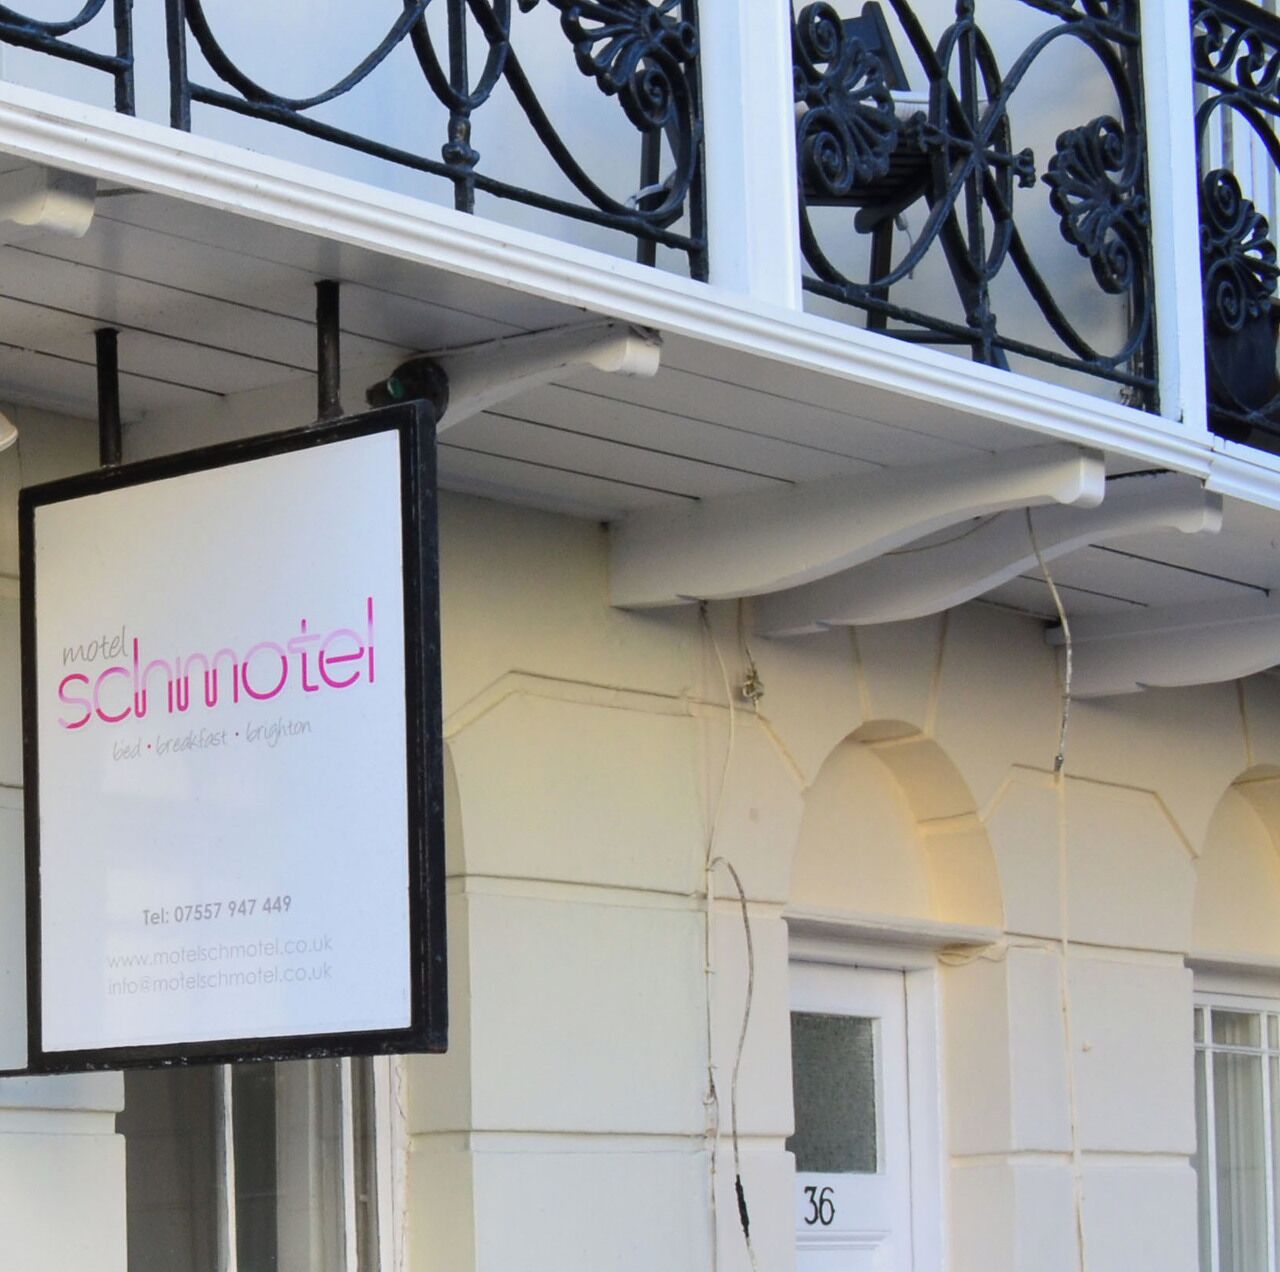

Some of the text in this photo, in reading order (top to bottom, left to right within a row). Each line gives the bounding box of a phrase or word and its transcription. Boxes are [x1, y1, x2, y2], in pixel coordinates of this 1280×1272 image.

[58, 597, 375, 729] schmotel
[62, 624, 129, 666] motel
[112, 720, 312, 762] bed breakfast brighton
[142, 895, 292, 926] Tel: 07557 947 449
[106, 933, 334, 969] www.motelschmotel.co.uk
[107, 962, 333, 996] info@motelschmotel.co.uk
[803, 1185, 836, 1226] 36
